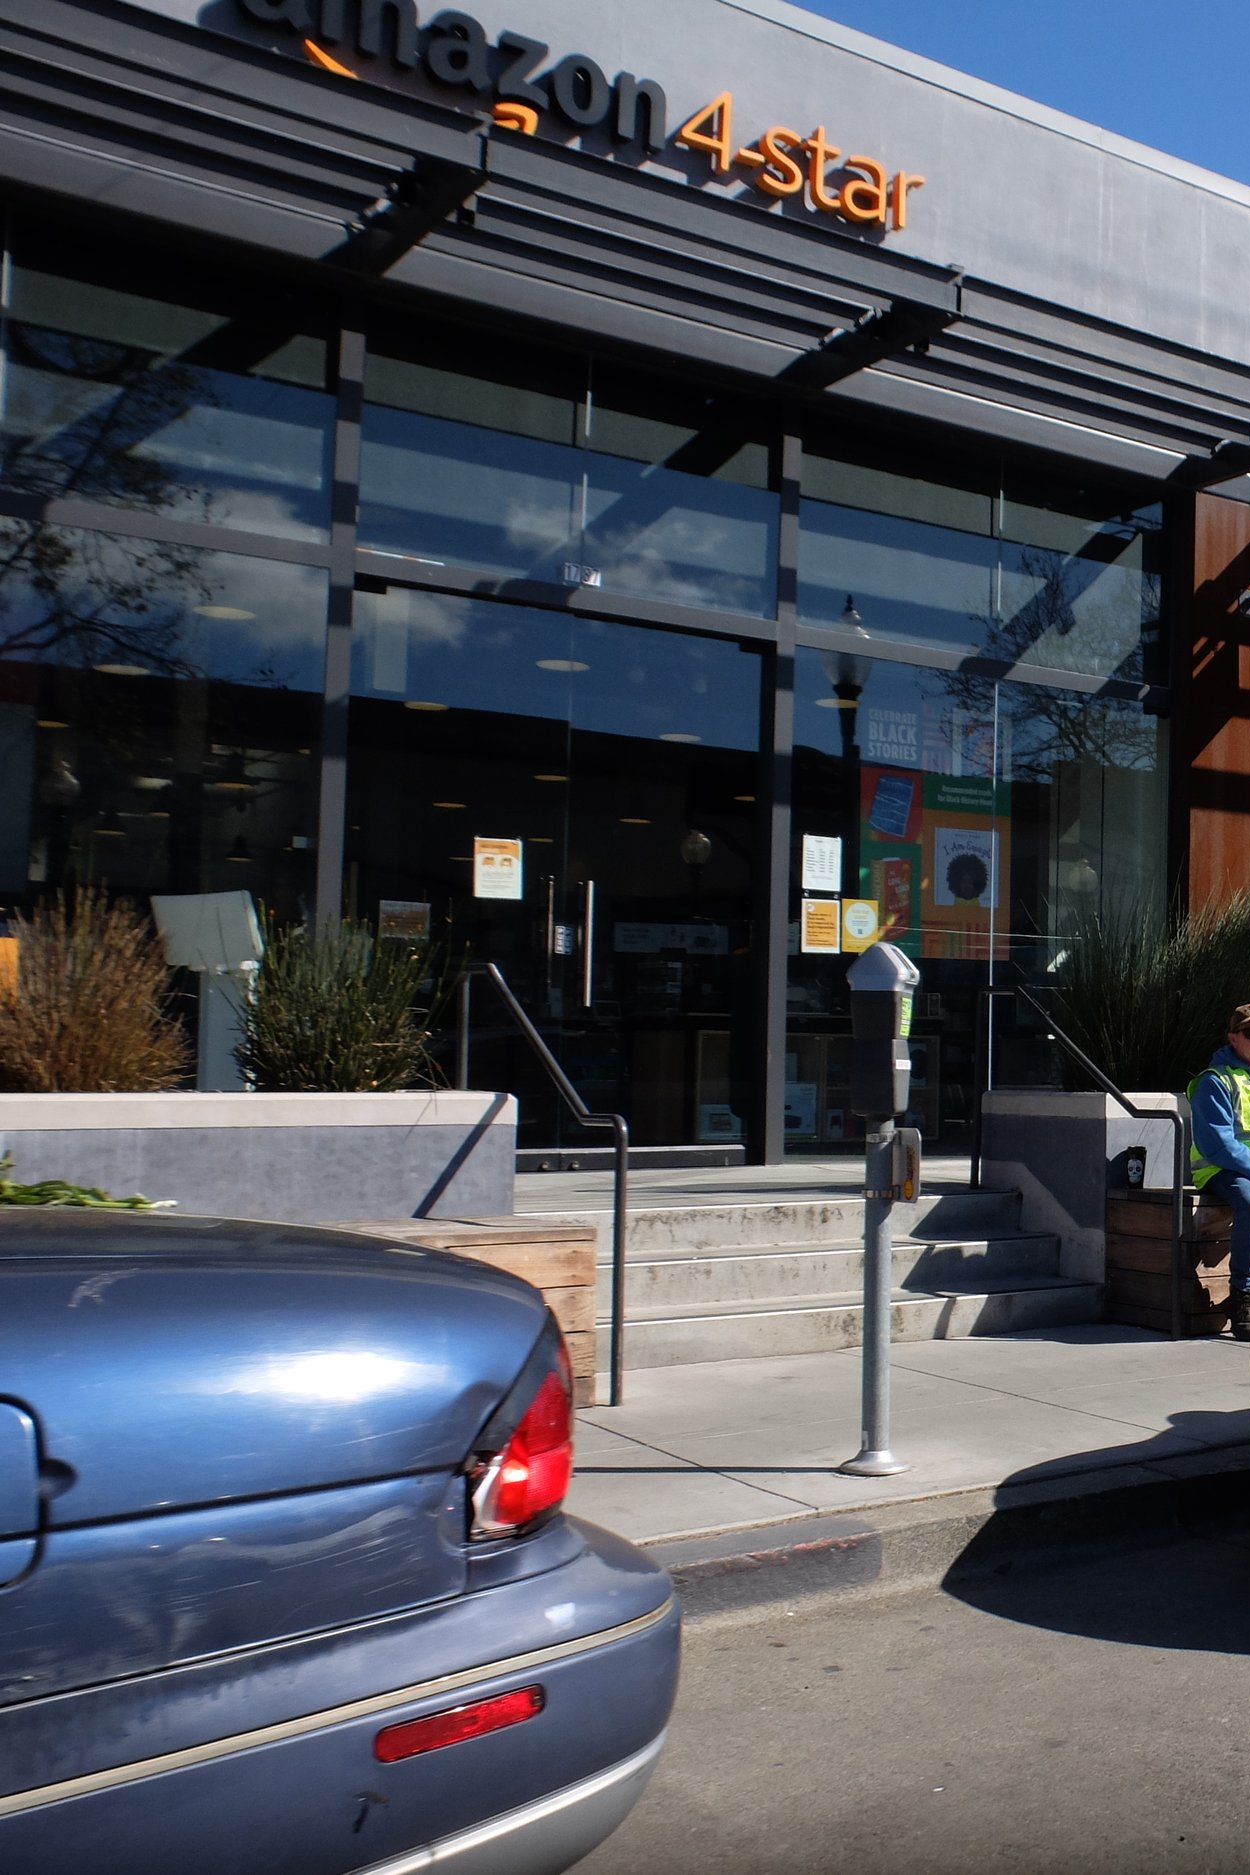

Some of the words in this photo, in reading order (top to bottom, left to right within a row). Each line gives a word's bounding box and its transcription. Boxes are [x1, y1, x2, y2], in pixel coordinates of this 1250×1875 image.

[680, 91, 926, 230] 4-star
[868, 720, 917, 745] BLACK
[868, 741, 917, 761] STORIES
